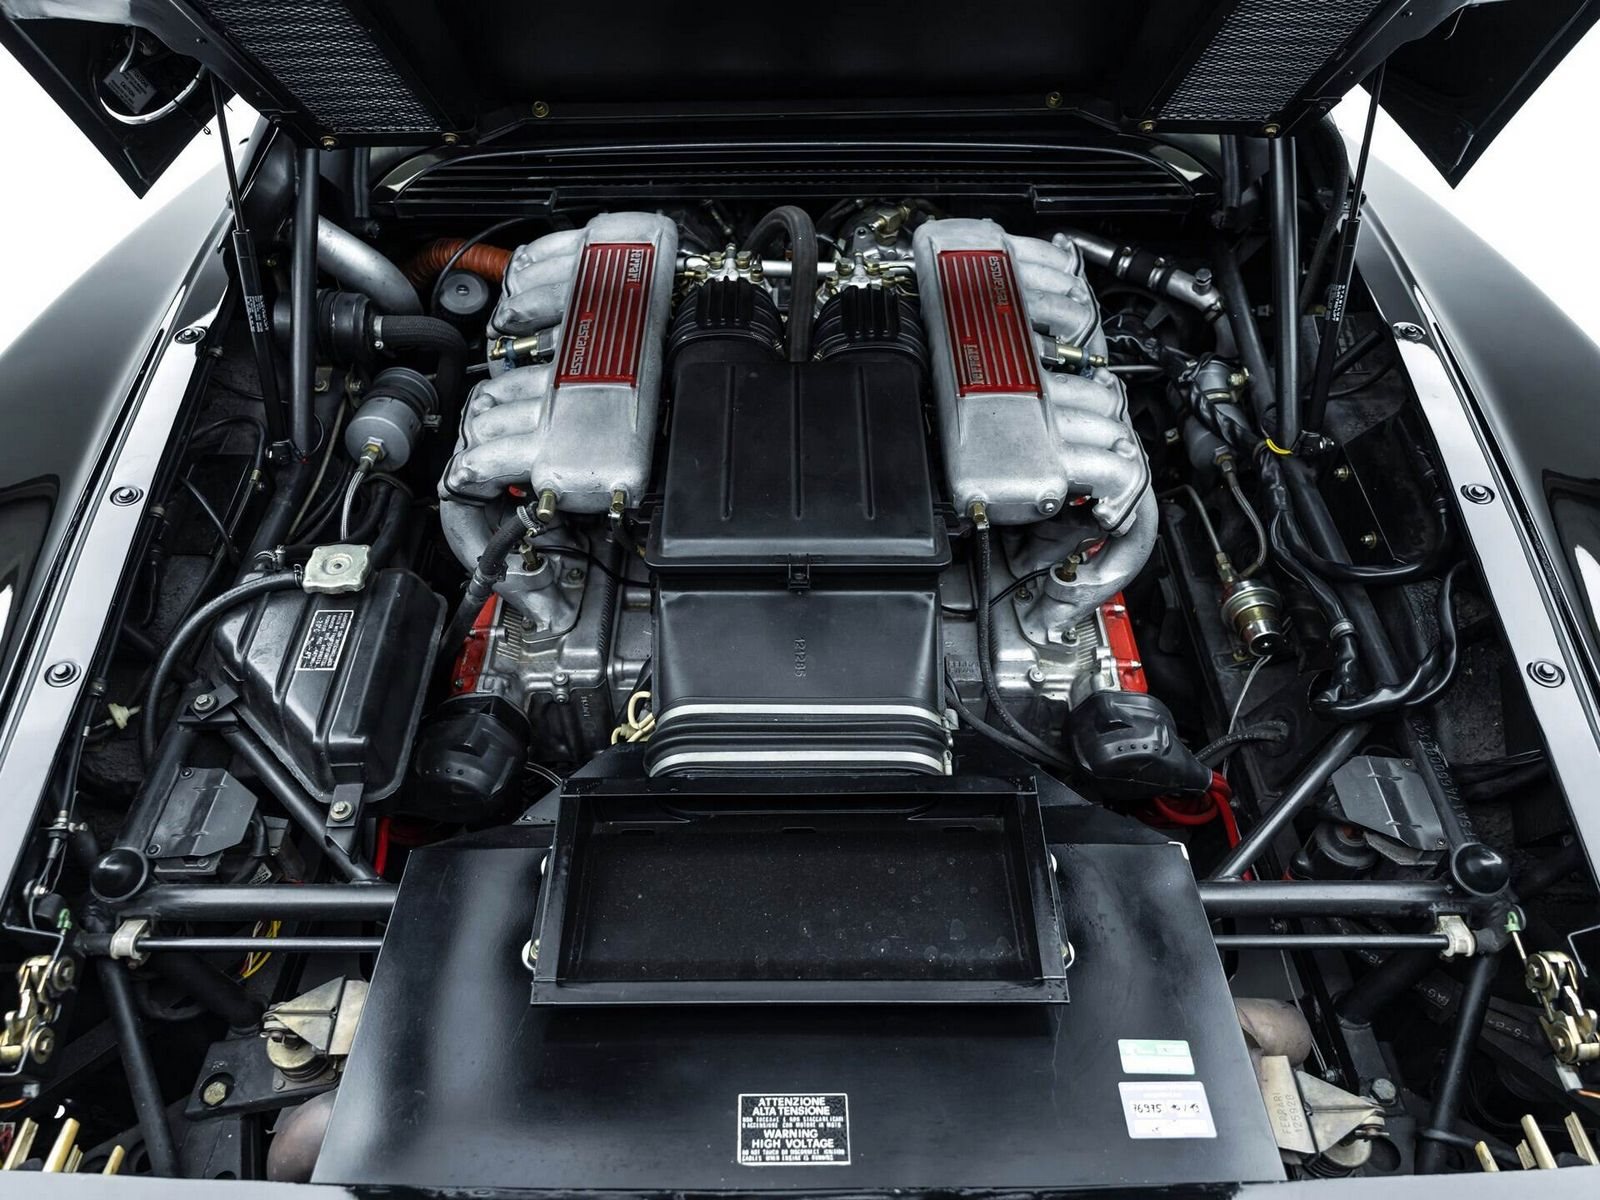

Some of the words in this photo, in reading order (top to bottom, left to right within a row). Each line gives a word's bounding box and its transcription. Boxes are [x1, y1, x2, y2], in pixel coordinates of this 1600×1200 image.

[627, 249, 644, 283] Ferrari
[758, 1097, 825, 1106] ATTENZIONE
[752, 1106, 777, 1116] ALTA
[778, 1106, 830, 1116] TENSIONE
[1273, 1093, 1292, 1135] FERRARI
[764, 1129, 818, 1139] WARNING
[752, 1139, 780, 1148] HIGH
[786, 1139, 834, 1148] VOLTAGE
